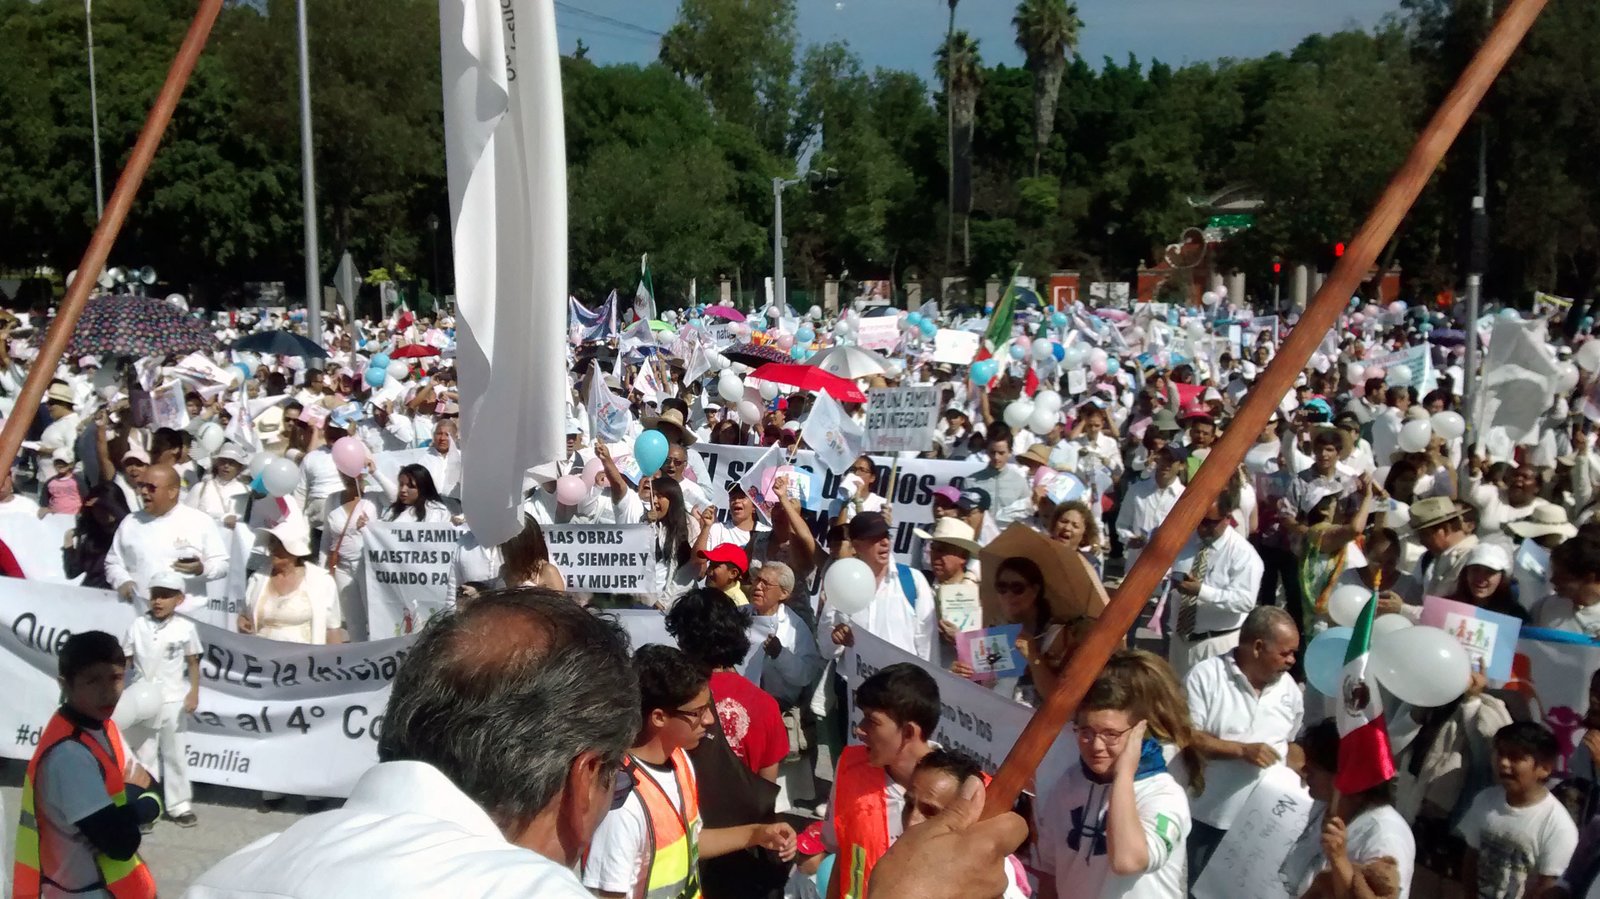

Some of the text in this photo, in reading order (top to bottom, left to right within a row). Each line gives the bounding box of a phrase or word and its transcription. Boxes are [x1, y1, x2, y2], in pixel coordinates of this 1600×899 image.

[417, 529, 464, 543] FAMIL
[549, 530, 573, 544] LAS
[577, 530, 623, 544] OBRAS
[369, 550, 437, 564] MAESTRAS
[441, 551, 454, 564] D
[577, 552, 636, 567] SIEMPRE
[639, 552, 649, 567] Y
[375, 570, 428, 586] CUANDO
[576, 574, 586, 589] Y
[271, 659, 299, 687] la
[235, 705, 273, 734] al
